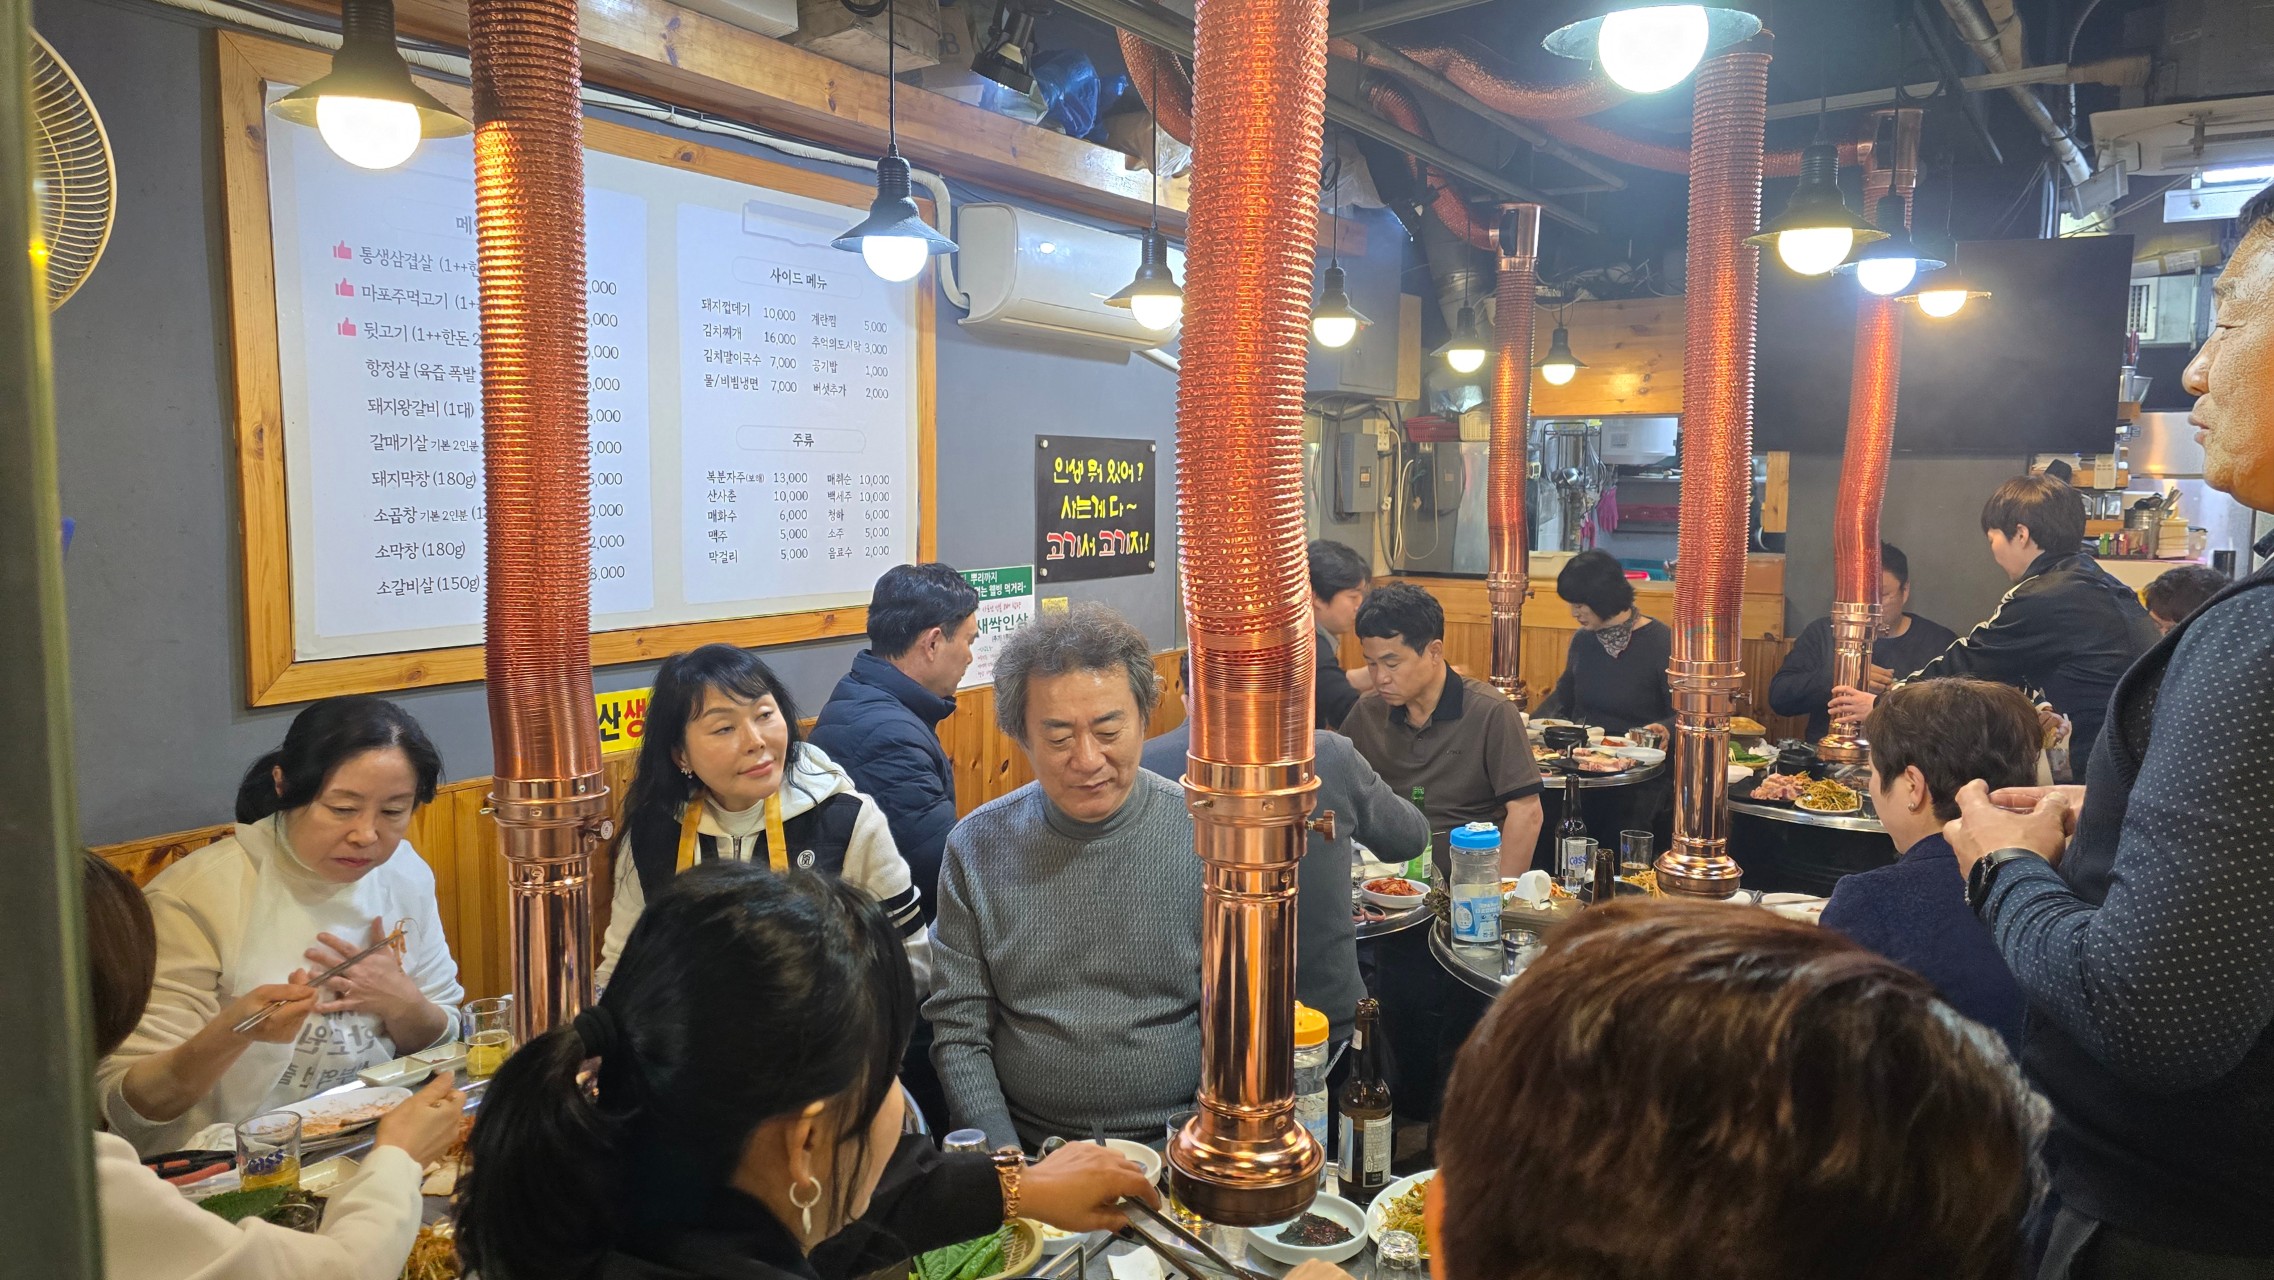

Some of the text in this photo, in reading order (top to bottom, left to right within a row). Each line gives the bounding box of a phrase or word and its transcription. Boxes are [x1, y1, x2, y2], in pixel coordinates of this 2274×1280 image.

[455, 215, 475, 235] 메
[359, 246, 433, 273] 통생삼겹살
[770, 267, 827, 290] 사이드 메뉴
[361, 284, 448, 310] 마포주먹고기
[701, 298, 796, 322] 돼지껍데기 10,000
[586, 312, 618, 328] ,000
[811, 313, 888, 334] 계란찜 5,000
[363, 321, 408, 343] 뒷고기
[412, 324, 469, 348] (1++한돈
[702, 323, 797, 346] 김치찌개 16,000
[811, 336, 888, 356] 추억의도시락 3,000
[703, 349, 797, 370] 김치말이국수 7,000
[812, 359, 889, 378] 공기밥 1,000
[365, 359, 477, 383] 항정살 (육즙 폭발
[704, 373, 798, 393] 물/비빔냉면 7,000
[813, 383, 889, 400] 버섯추가 2,000
[367, 397, 475, 419] 돼지왕갈비 (1대)
[370, 433, 479, 452] 갈매기살 기본 2인분
[792, 433, 815, 448] 주류
[371, 470, 477, 490] 돼지막창 (180g)
[773, 472, 808, 485] 13,000
[827, 472, 890, 487] 매취순 10,000
[1053, 457, 1084, 484] 인생
[1087, 458, 1103, 484] 뭐
[707, 489, 809, 504] 산사춘 10,000
[827, 490, 890, 504] 백세주 10,000
[373, 506, 418, 525] 소곱창
[419, 510, 440, 523] 기본
[442, 509, 469, 522] 2인분
[707, 509, 808, 523] 매화수 6,000
[828, 508, 890, 522] 청하 6,000
[1060, 495, 1106, 520] 사는게
[708, 528, 808, 543] 맥주 5,000
[828, 527, 890, 540] 소주 5,000
[374, 541, 466, 560] 소막창 (180g)
[828, 545, 890, 560] 음료수 2,000
[1046, 528, 1150, 560] 고기서 고기지!
[708, 548, 809, 564] 막걸리 5,000
[376, 574, 481, 597] 소갈비살 (150g)
[970, 570, 998, 585] 뿌리까지
[989, 583, 1003, 597] 웰빙
